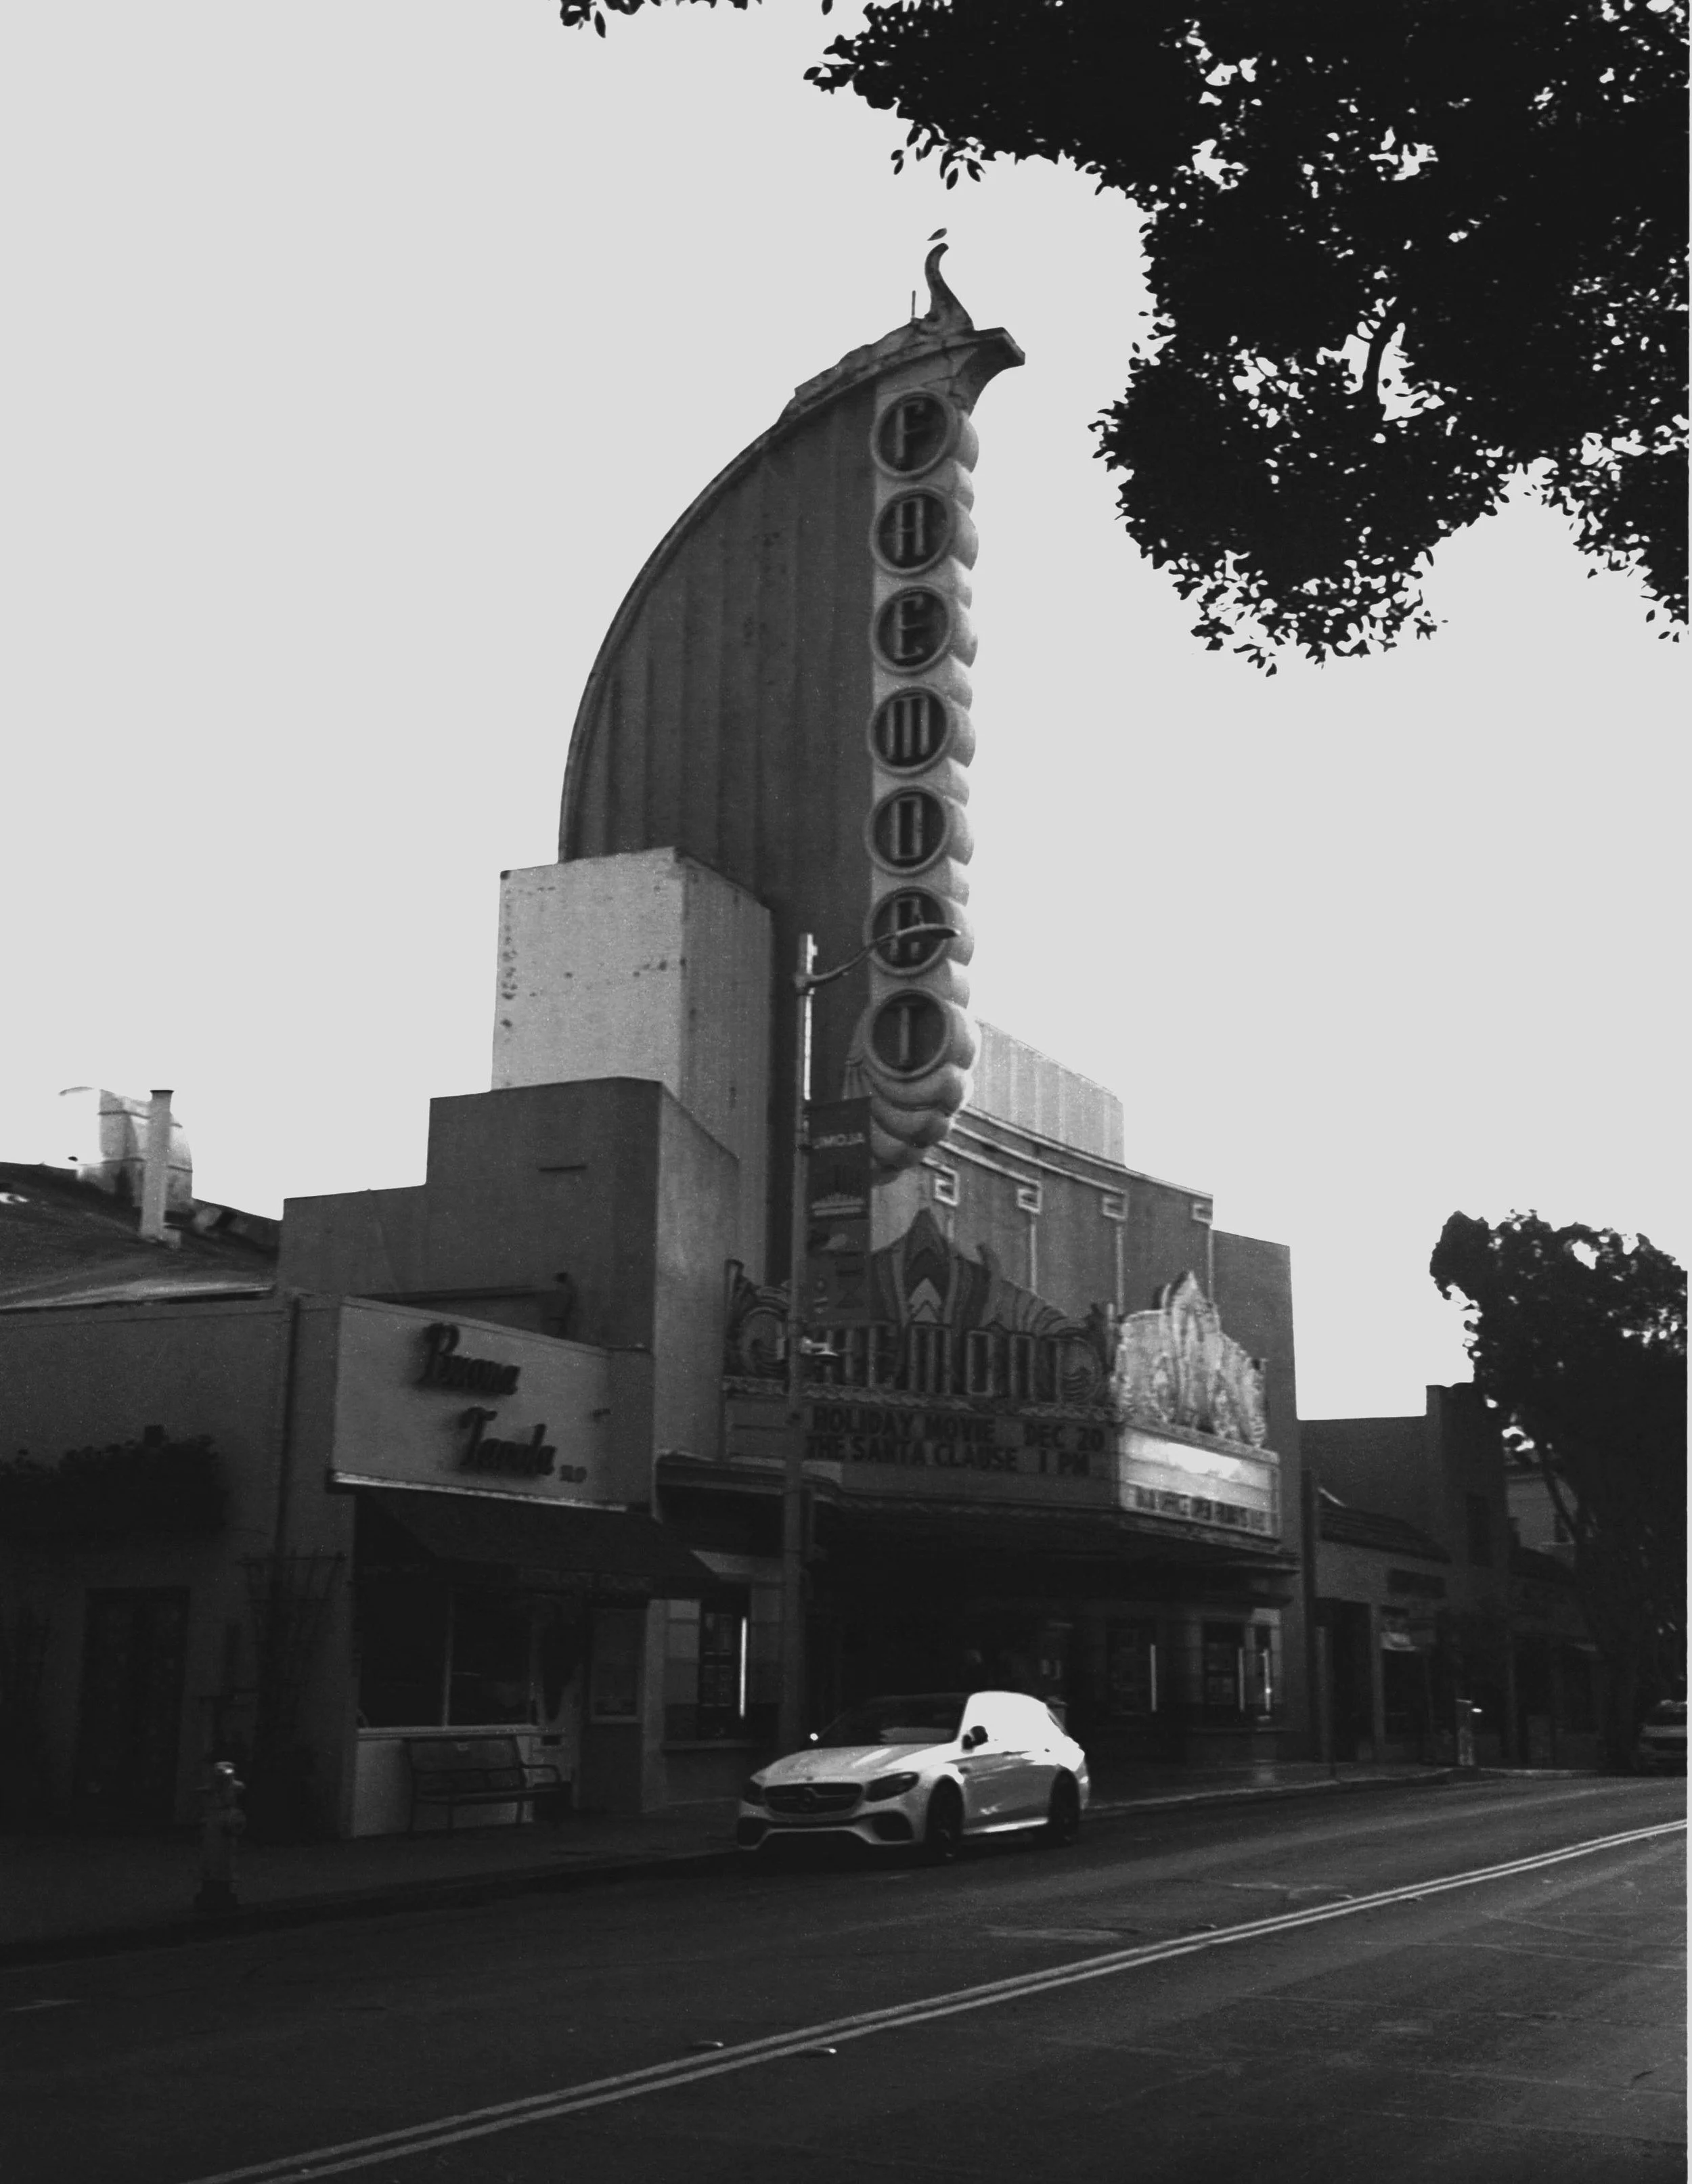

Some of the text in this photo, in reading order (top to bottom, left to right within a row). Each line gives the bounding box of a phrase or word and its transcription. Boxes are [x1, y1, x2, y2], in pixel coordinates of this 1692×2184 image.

[813, 1406, 1105, 1452] HOLIDAY MOVIE DEC 20
[806, 1429, 846, 1458] THE
[851, 1429, 926, 1467] SANTA
[935, 1438, 1018, 1472] CLAUSE
[1056, 1452, 1090, 1477] PM
